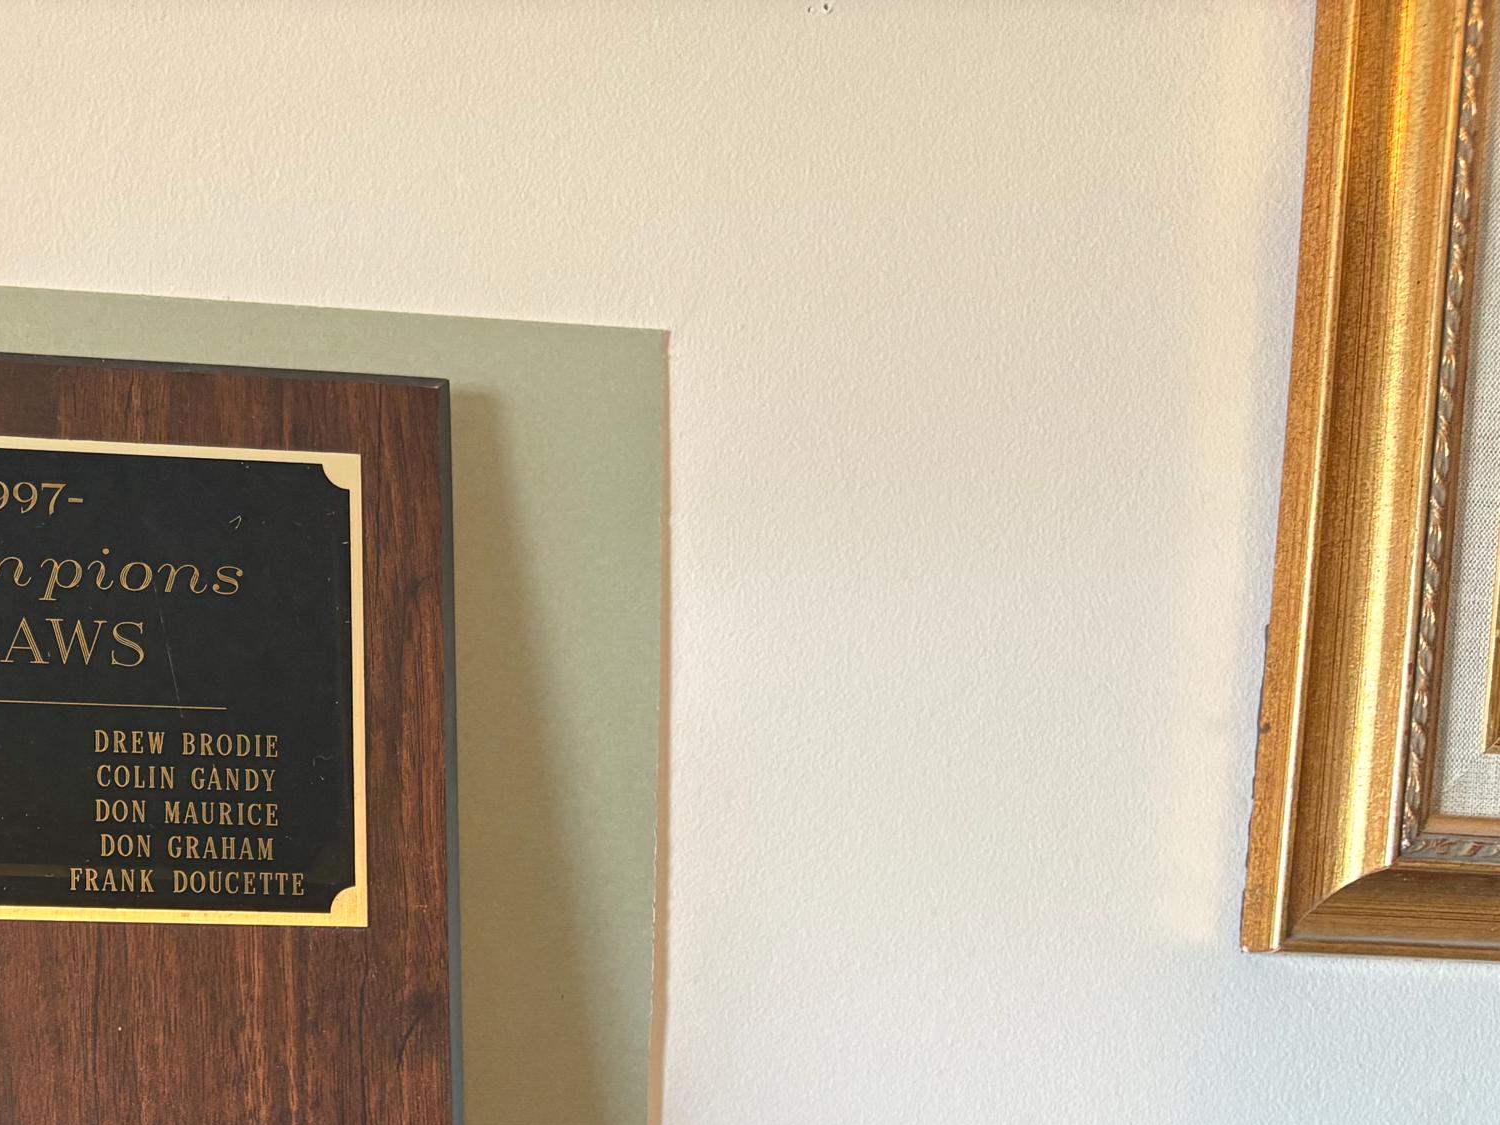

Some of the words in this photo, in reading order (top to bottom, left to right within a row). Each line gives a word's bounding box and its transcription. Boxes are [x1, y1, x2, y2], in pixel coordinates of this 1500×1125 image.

[94, 730, 165, 754] DREW
[182, 732, 278, 757] BRODIE
[96, 765, 174, 789] COLIN
[191, 767, 276, 792] GANDY
[95, 799, 146, 823] DON
[164, 801, 278, 826] MAURICE
[100, 834, 151, 857] DON
[168, 836, 274, 861] GRAHAM
[70, 868, 154, 893] FRANK
[173, 870, 304, 896] DOUCETTE
